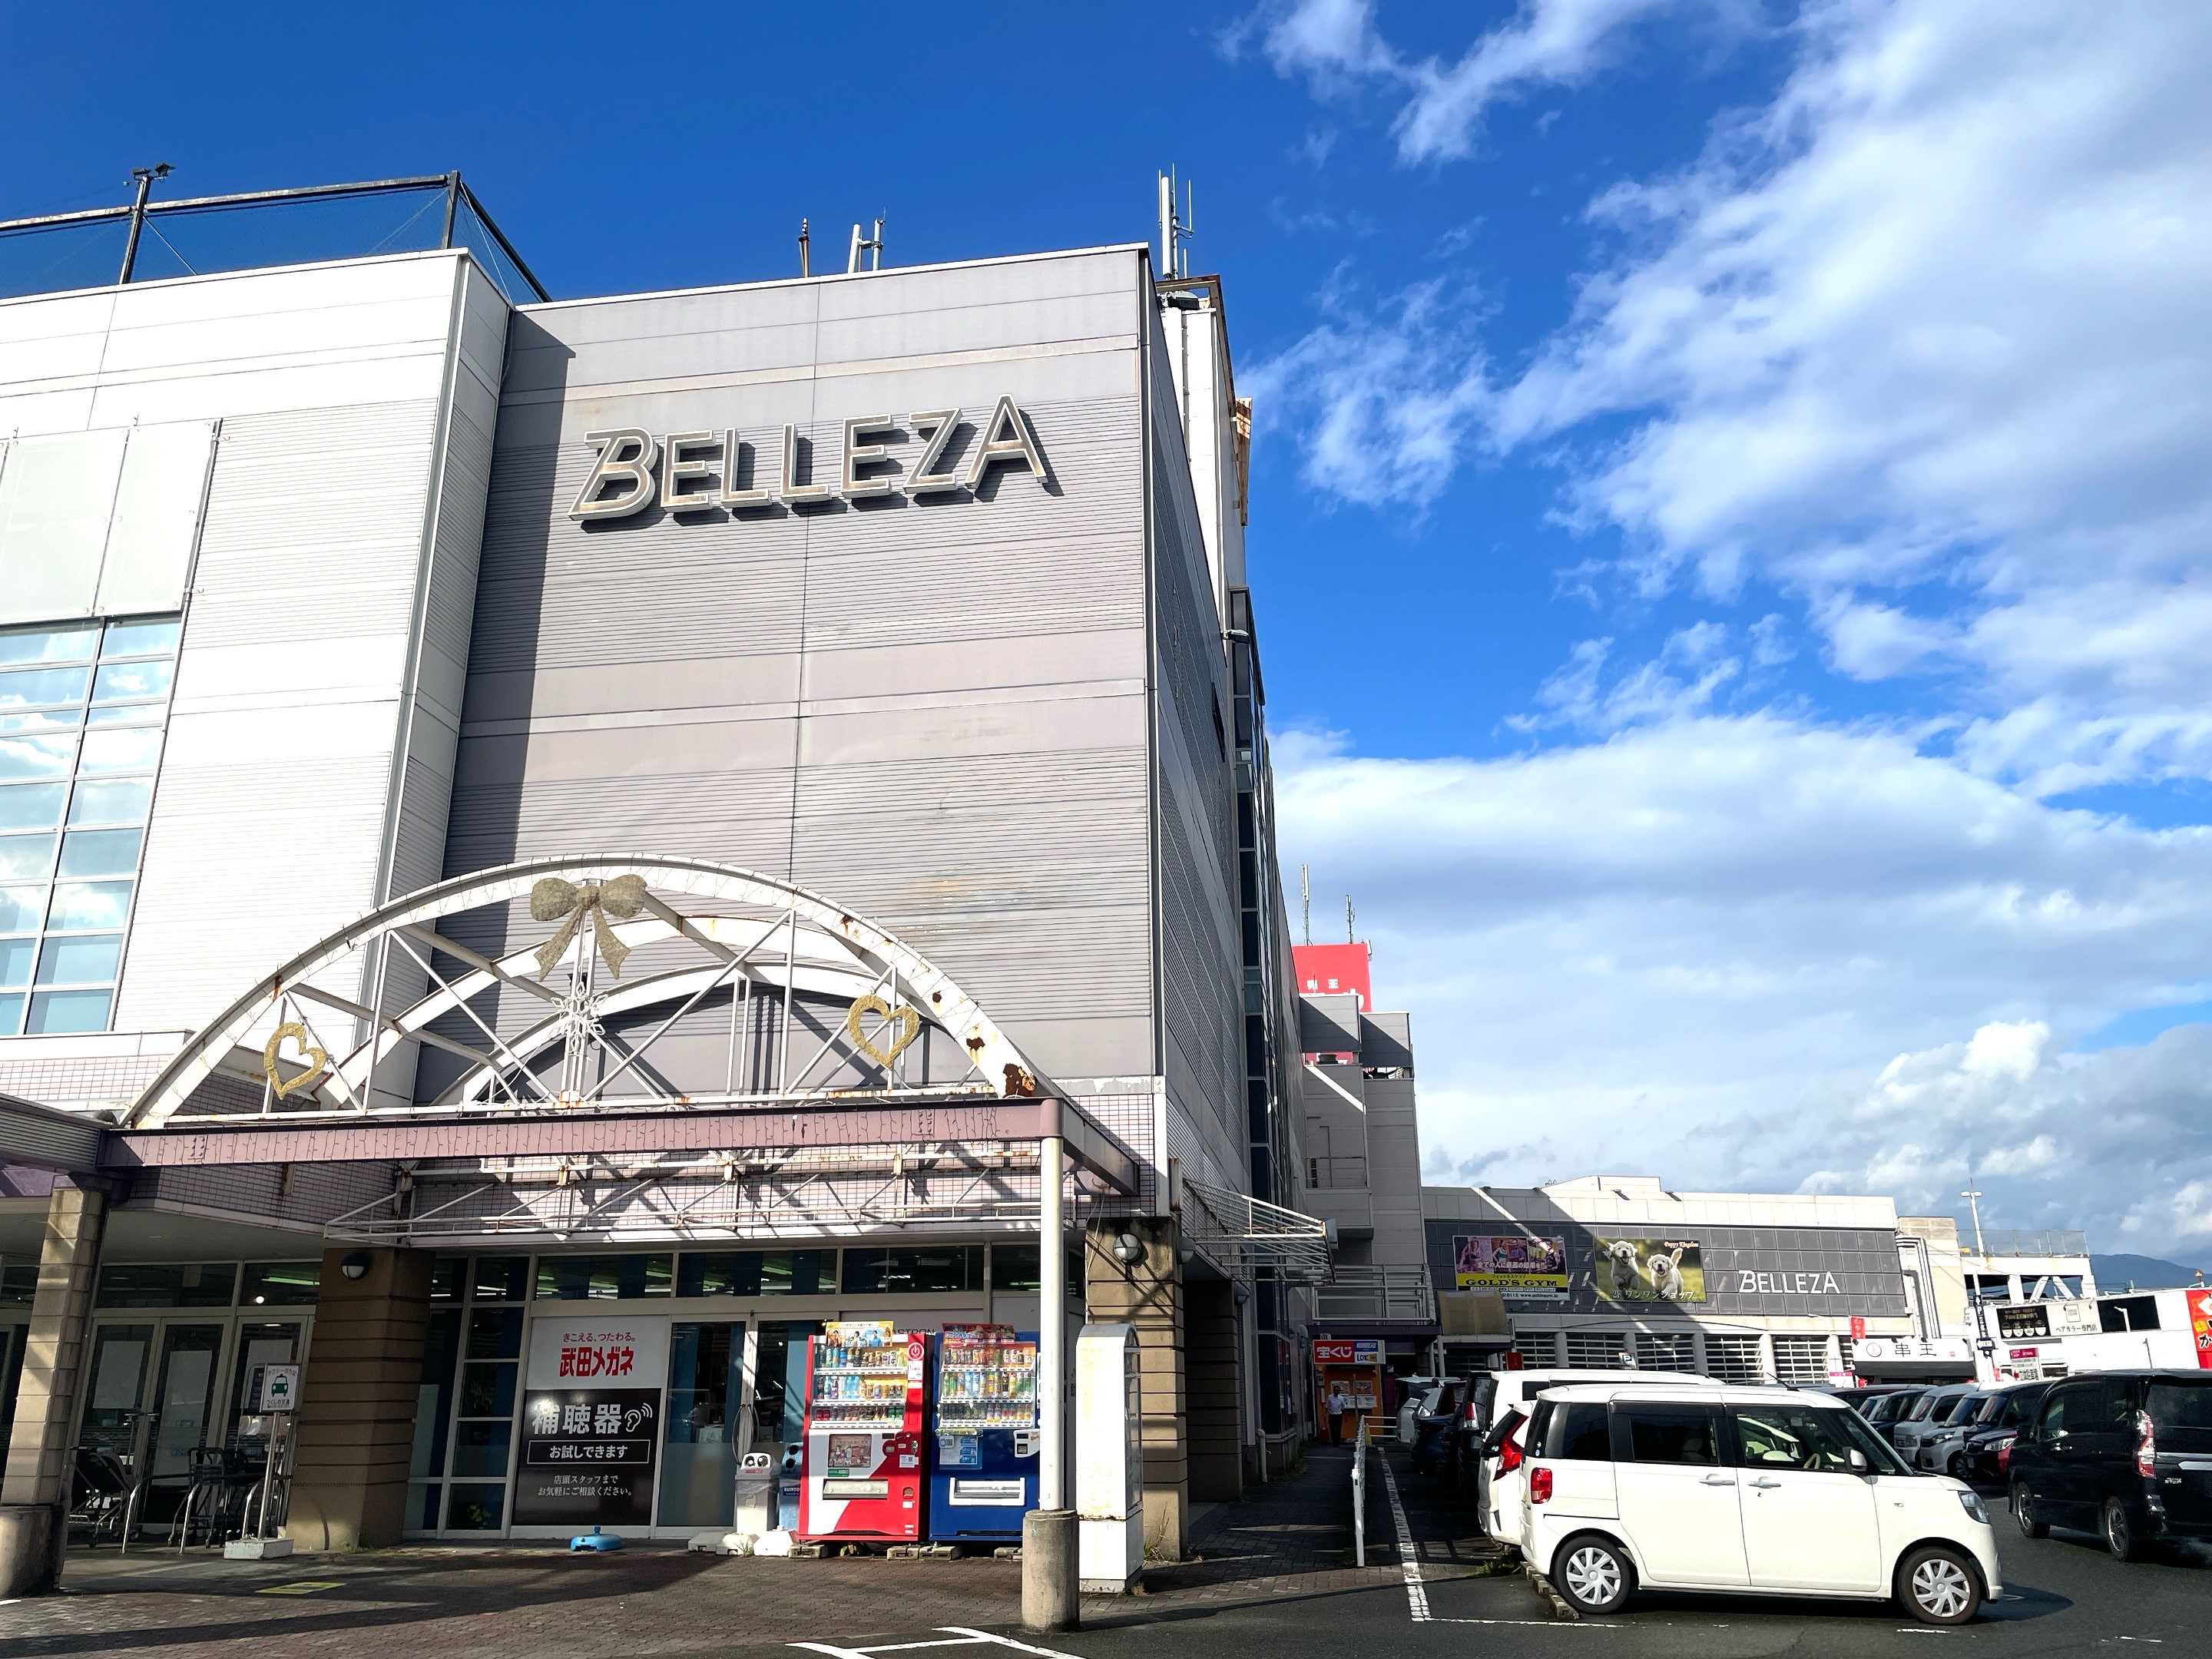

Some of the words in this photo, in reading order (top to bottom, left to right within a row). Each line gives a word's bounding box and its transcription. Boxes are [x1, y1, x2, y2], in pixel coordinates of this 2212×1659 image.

[568, 393, 1049, 521] BELLEZA
[1739, 1270, 1840, 1293] BELLEZA
[2055, 1324, 2098, 1333] ヘアカラー専門店
[563, 1332, 636, 1343] きこえる、つたわる。
[1316, 1346, 1353, 1359] 宝くじ
[559, 1346, 634, 1377] 武田メガネ
[531, 1402, 622, 1435] 補聴器
[549, 1445, 628, 1459] お試しできます
[553, 1475, 618, 1485] 店頭スタッフまで
[538, 1485, 632, 1497] お気軽にご相談ください。
